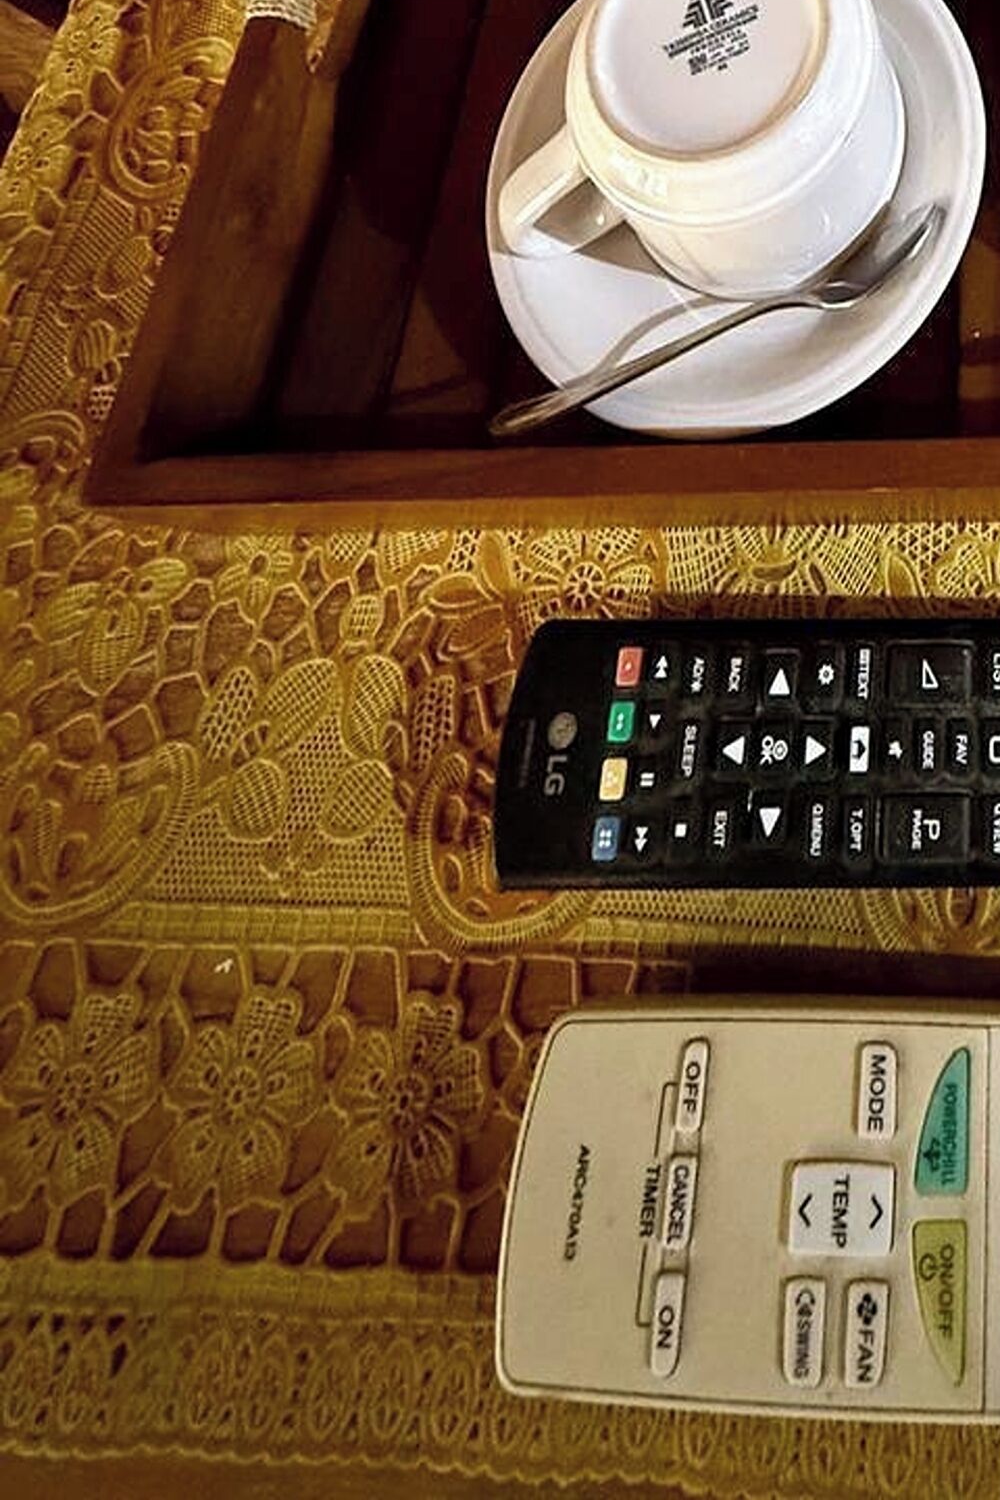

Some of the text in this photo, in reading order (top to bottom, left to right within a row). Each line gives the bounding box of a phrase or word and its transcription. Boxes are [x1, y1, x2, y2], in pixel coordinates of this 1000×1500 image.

[728, 657, 742, 692] BACK
[543, 755, 568, 796] LG
[681, 725, 697, 778] SLEEP
[760, 735, 773, 765] OK
[922, 730, 934, 769] GUIDE
[956, 735, 967, 765] FAV
[714, 810, 728, 848] EXIT
[911, 809, 922, 851] PAGE
[923, 819, 940, 841] P
[683, 1061, 700, 1114] OFF
[867, 1053, 887, 1133] MODE
[941, 1082, 958, 1185] POWERCHILL
[640, 1164, 661, 1239] TIMER
[667, 1165, 690, 1244] CANCEL
[831, 1174, 851, 1249] TEMP
[938, 1243, 954, 1337] ON/OFF
[657, 1306, 676, 1350] ON
[795, 1323, 814, 1378] SWING
[857, 1329, 874, 1382] FAN
